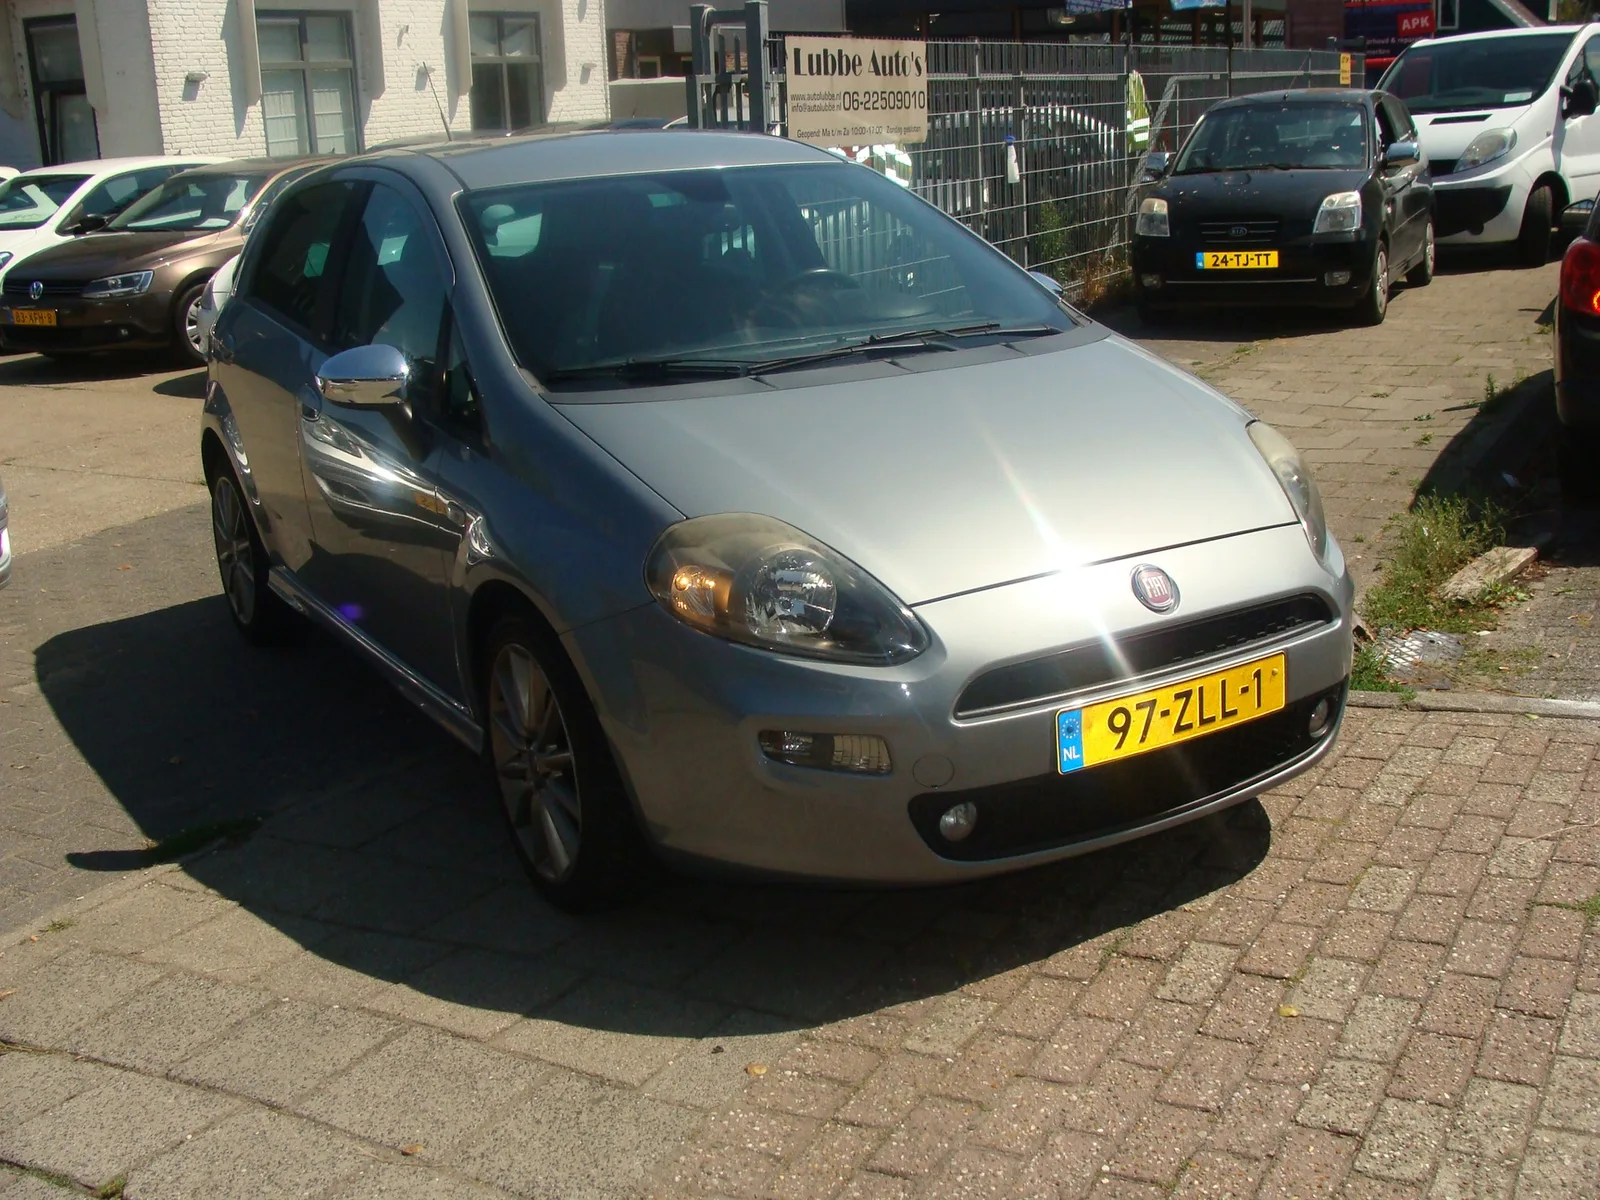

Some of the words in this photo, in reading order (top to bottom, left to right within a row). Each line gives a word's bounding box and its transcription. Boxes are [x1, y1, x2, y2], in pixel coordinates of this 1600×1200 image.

[1402, 16, 1430, 31] APK
[793, 48, 862, 76] Lubbe
[868, 49, 922, 77] Auto's
[790, 91, 841, 102] www.autolubbe.nl
[842, 90, 926, 111] 06-22509010
[791, 101, 841, 113] info@autolubbe.nl
[1211, 253, 1271, 267] 24-TJ-TT
[1141, 575, 1168, 599] FIAT
[1107, 667, 1262, 750] 97-ZLL-1
[1063, 746, 1081, 761] NL
